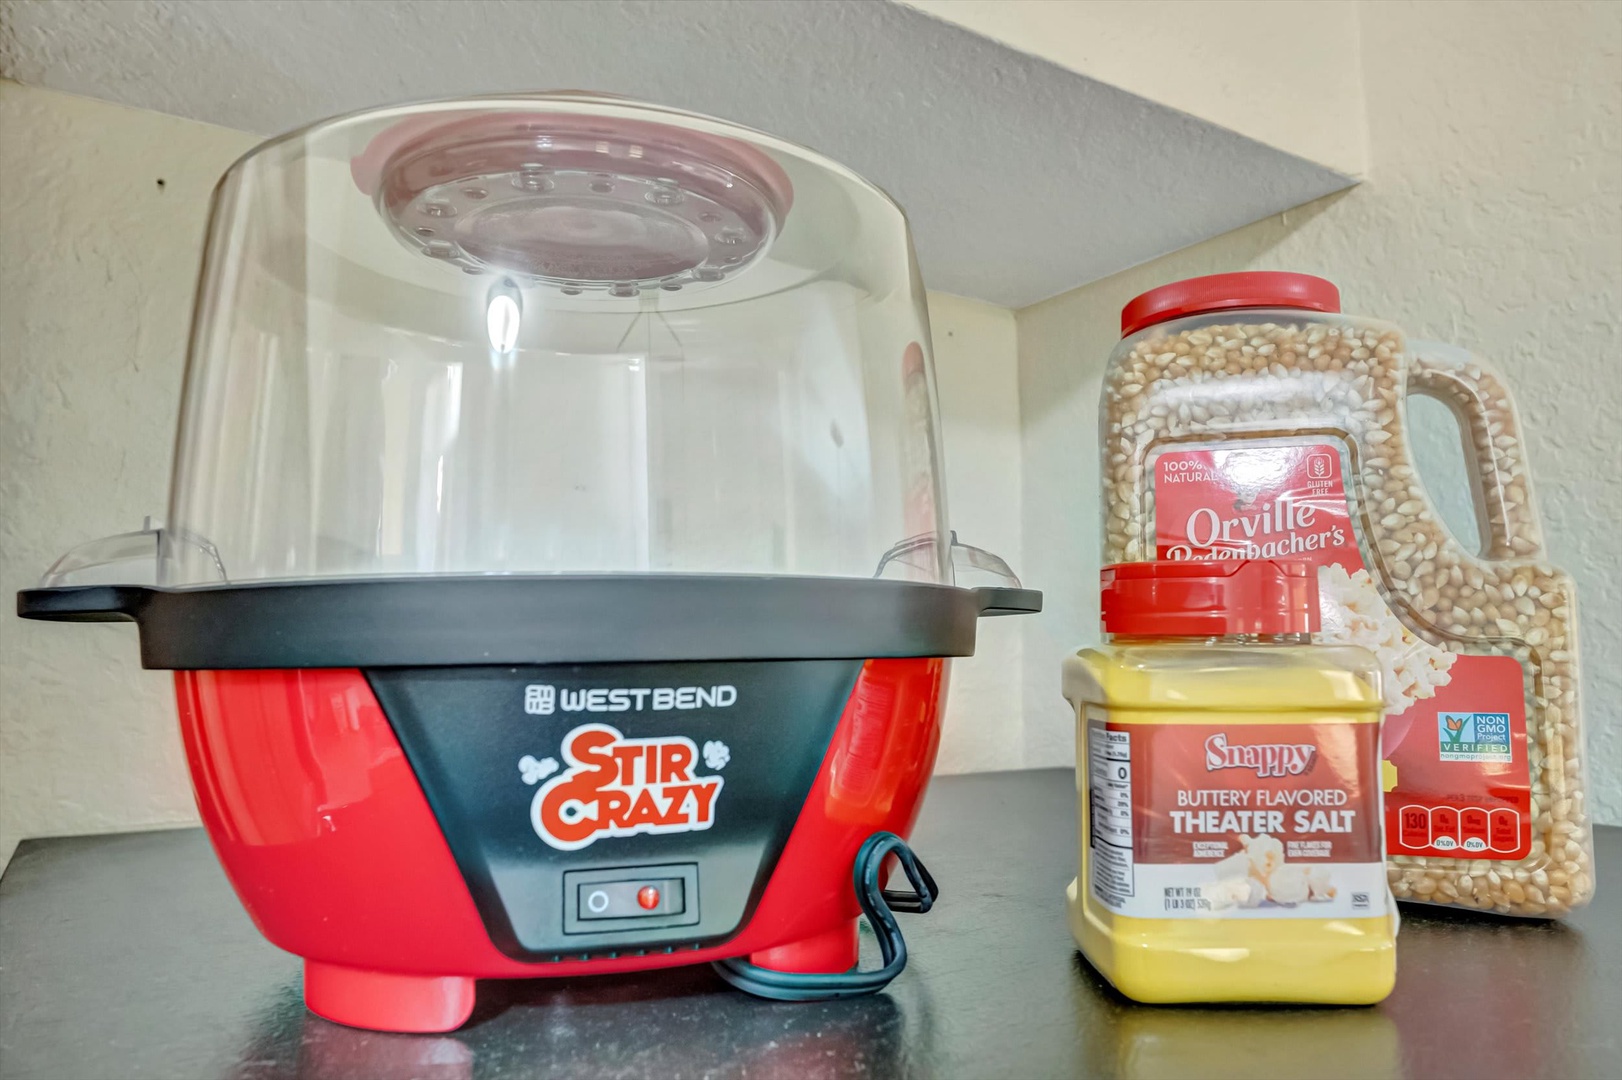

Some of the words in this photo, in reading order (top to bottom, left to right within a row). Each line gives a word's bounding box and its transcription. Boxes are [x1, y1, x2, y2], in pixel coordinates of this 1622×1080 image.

[1163, 460, 1202, 472] 100%
[1163, 472, 1217, 484] NATURAL
[1306, 480, 1333, 489] GLUTEN
[1311, 487, 1329, 496] FREE
[1186, 498, 1316, 548] Orville
[560, 687, 651, 712] WEST
[652, 685, 738, 711] BEND
[1476, 715, 1505, 725] NON
[1476, 724, 1506, 734] GMO
[1477, 732, 1506, 742] Project
[1443, 743, 1508, 753] VERIFIED
[567, 726, 696, 790] STIR
[1204, 732, 1316, 777] Snappy
[1440, 752, 1511, 762] nongmoprojtorg
[1177, 789, 1251, 807] BUTTERY
[1256, 789, 1348, 807] FLAVORED
[538, 768, 720, 843] CRAZY
[1169, 810, 1286, 834] THEATER
[1294, 810, 1356, 833] SALT
[1404, 812, 1427, 830] 130
